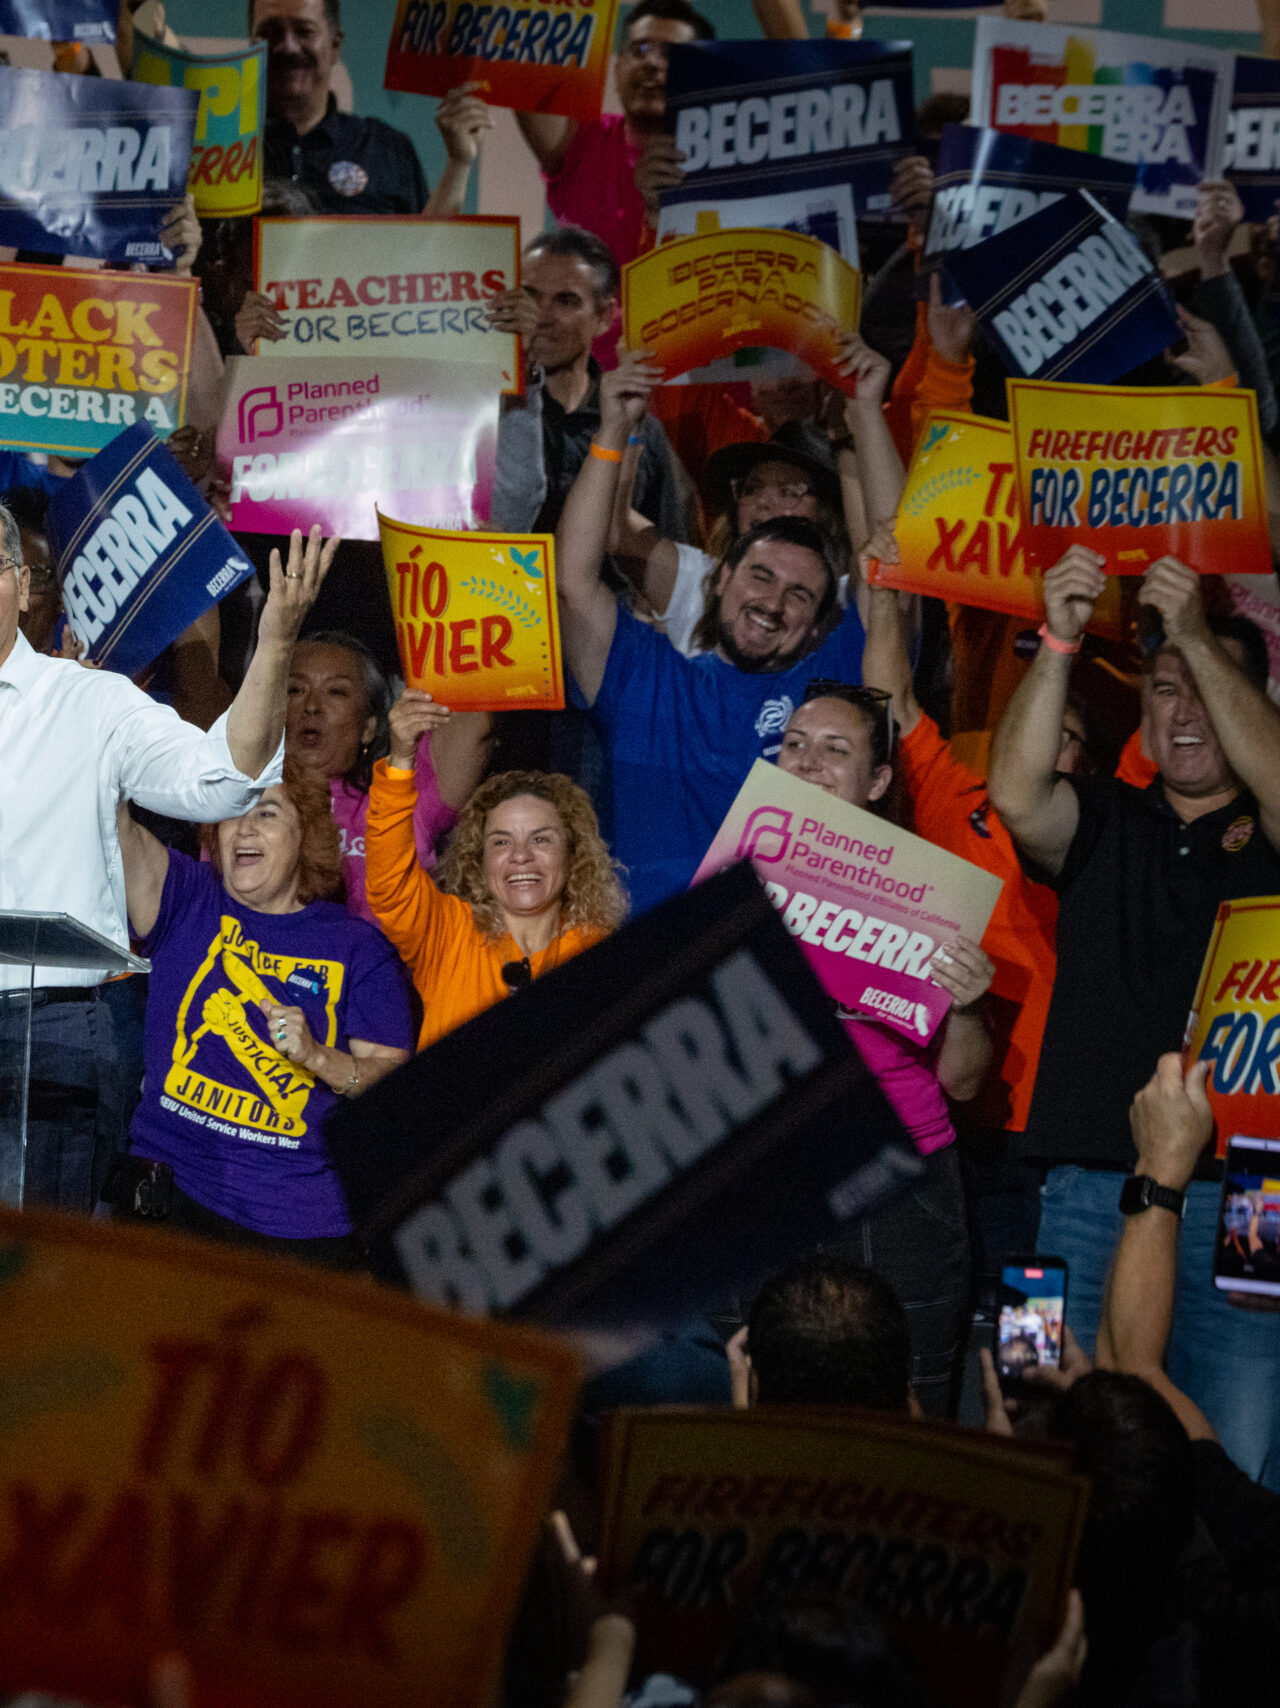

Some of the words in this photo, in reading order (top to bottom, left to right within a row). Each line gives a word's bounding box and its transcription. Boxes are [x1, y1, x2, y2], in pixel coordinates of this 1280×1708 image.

[398, 4, 448, 54] FOR
[449, 5, 597, 69] BECERRA
[675, 78, 902, 173] BECERRA
[925, 184, 1067, 257] BECER
[266, 270, 505, 311] TEACHERS
[641, 290, 826, 344] GOBERNADO
[991, 219, 1154, 376] BECERRA
[286, 307, 340, 344] OR
[347, 307, 494, 341] BECERR
[288, 374, 379, 400] Planned
[1026, 426, 1239, 463] FIREFIGHTERS
[1029, 466, 1088, 529] FOR
[1087, 461, 1244, 530] BECERRA
[62, 466, 194, 660] BECERRA
[927, 517, 1026, 578] XAV
[206, 564, 236, 598] BECERRA
[396, 545, 449, 619] TÍO
[398, 616, 515, 679] VIER
[790, 842, 927, 904] Parenthood
[799, 818, 894, 866] Planned
[223, 924, 282, 970] JUTICE
[859, 986, 916, 1022] BECERRA
[227, 1021, 312, 1100] JUSTICIA!
[178, 1105, 207, 1126] United
[207, 1117, 238, 1137] Service
[239, 1127, 277, 1146] Workers
[278, 1135, 301, 1150] West
[393, 948, 824, 1318] BECERRA
[137, 1302, 328, 1489] TÍO
[639, 1471, 1045, 1557] FIREFIGHTERS
[632, 1525, 751, 1607] FOR
